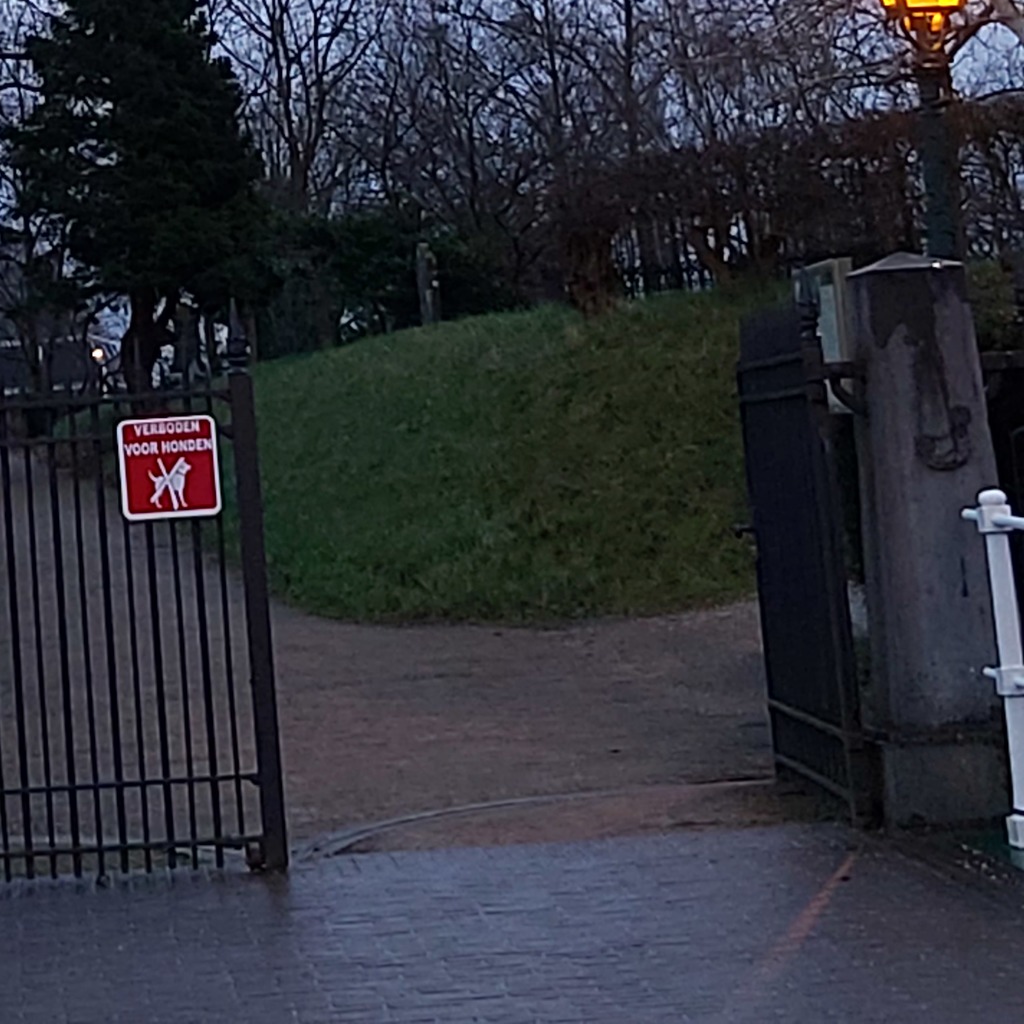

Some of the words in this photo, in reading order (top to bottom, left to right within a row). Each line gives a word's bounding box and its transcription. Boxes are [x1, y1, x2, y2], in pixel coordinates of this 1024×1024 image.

[134, 421, 200, 437] VERBODEN
[125, 442, 158, 456] VOOR
[161, 438, 212, 454] HONDEN
